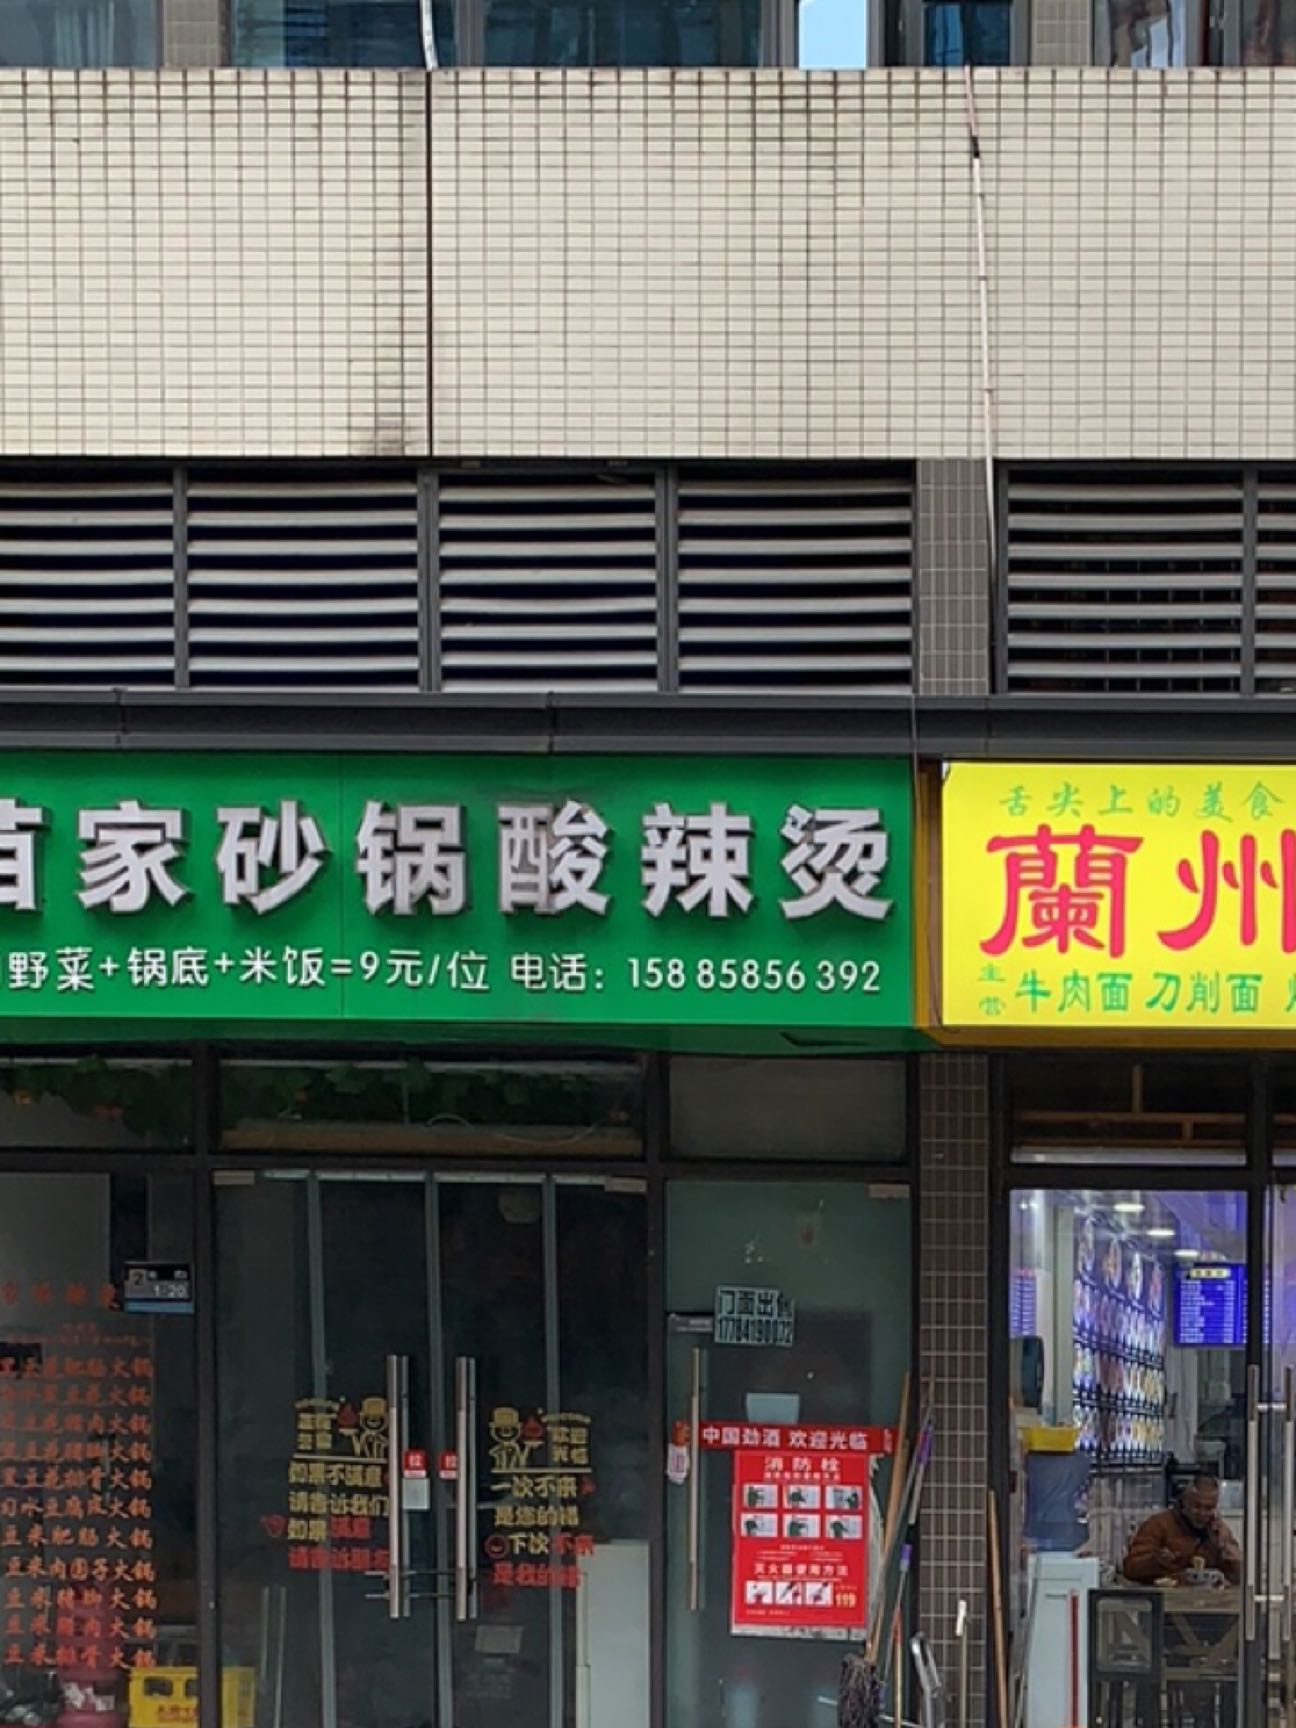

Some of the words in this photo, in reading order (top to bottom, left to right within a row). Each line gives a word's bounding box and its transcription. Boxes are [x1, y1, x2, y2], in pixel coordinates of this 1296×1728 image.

[999, 781, 1285, 823] 舌尖上的美食
